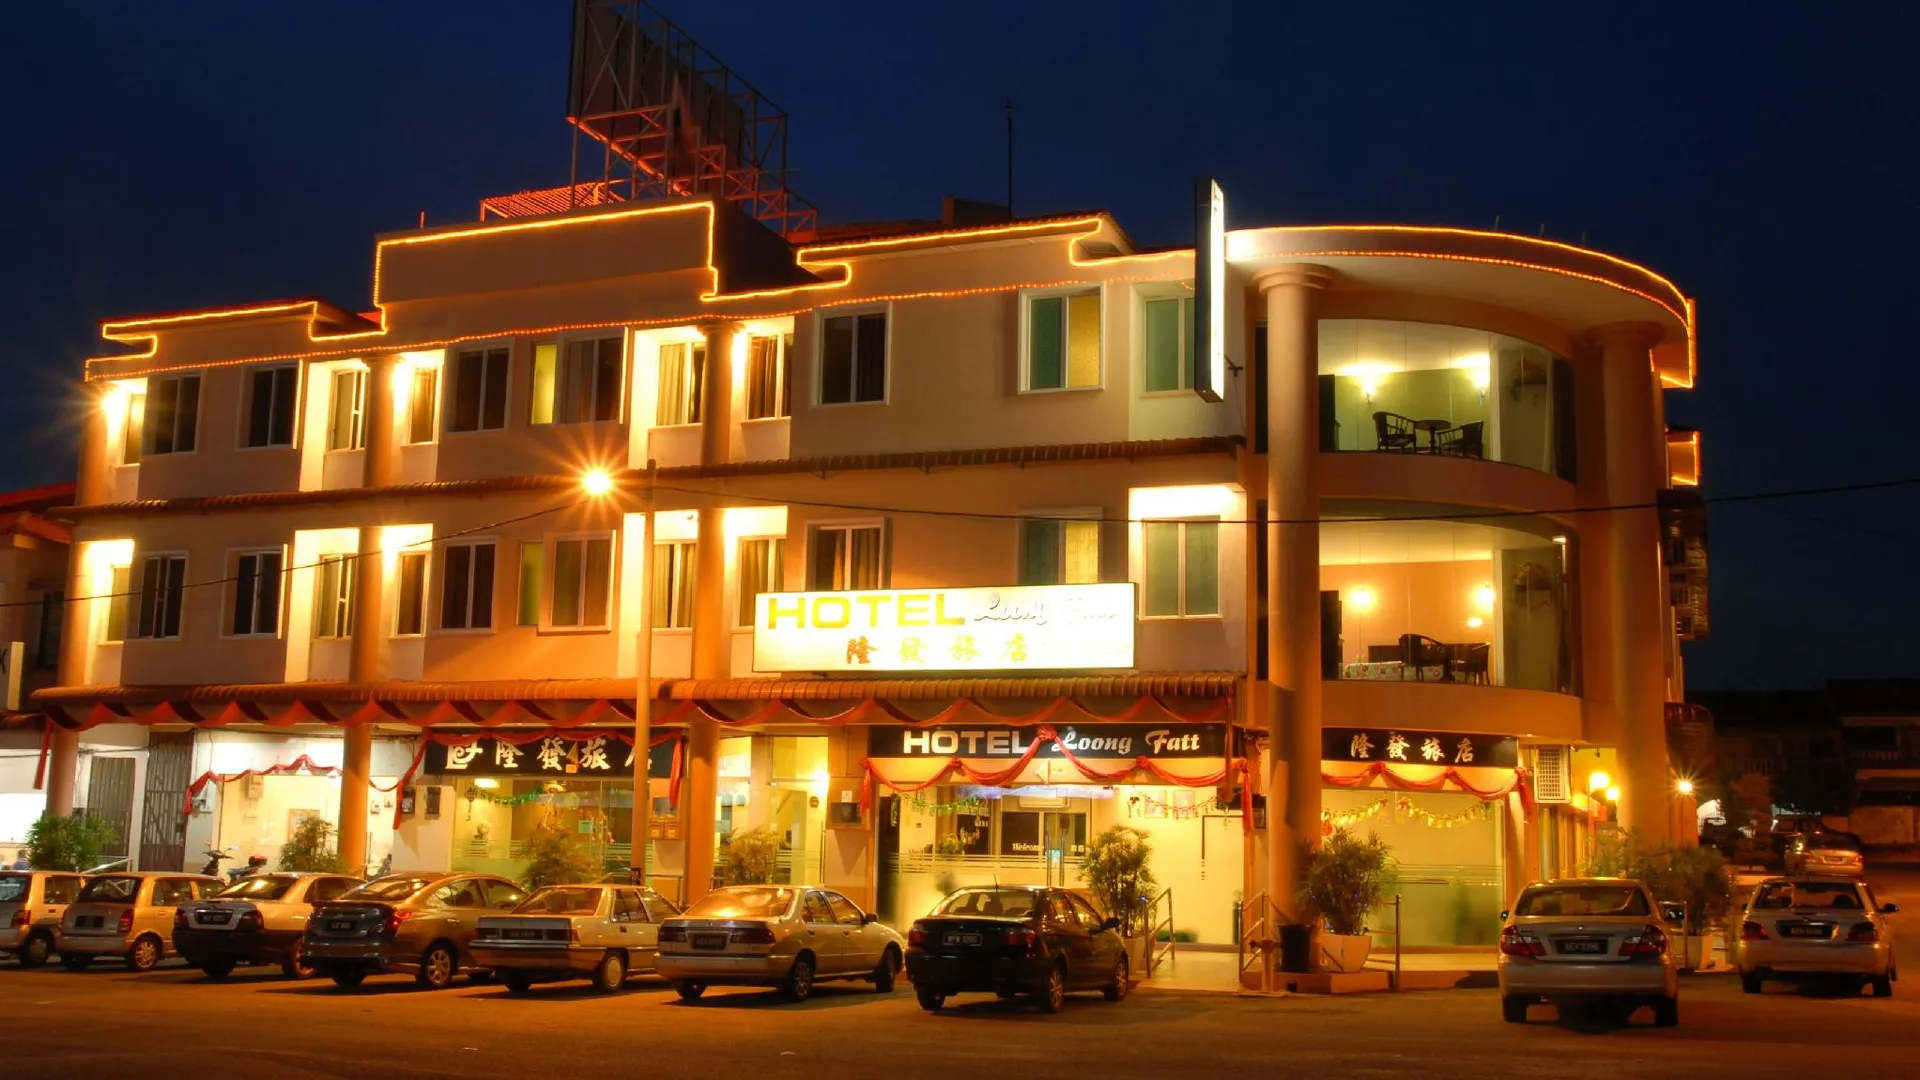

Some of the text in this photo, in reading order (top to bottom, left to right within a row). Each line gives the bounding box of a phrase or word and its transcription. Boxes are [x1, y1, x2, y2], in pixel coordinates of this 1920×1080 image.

[768, 593, 965, 629] HOTEL
[904, 729, 1200, 754] HOTEL Loong Fatt
[1350, 733, 1474, 763] 隆發旅店
